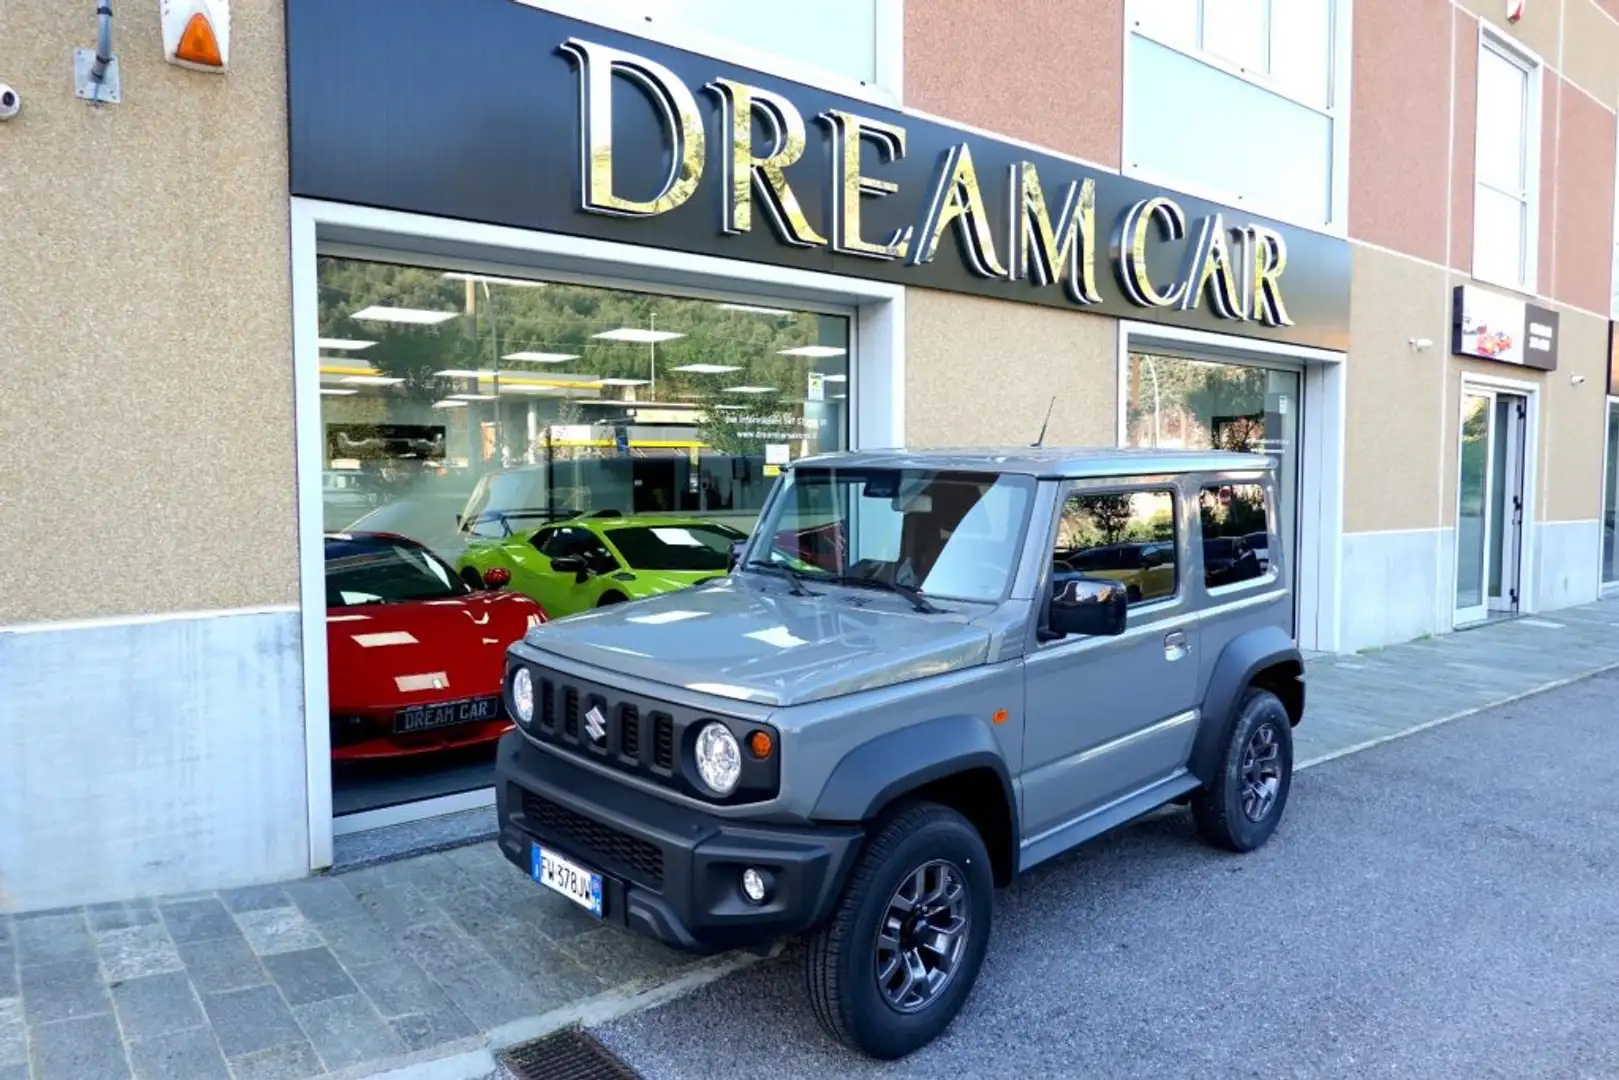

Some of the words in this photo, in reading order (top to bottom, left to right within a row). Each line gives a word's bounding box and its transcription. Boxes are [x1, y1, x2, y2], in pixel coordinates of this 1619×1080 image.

[558, 37, 1102, 305] DREAM
[1117, 196, 1295, 327] CAR
[405, 706, 455, 729] DREAM
[460, 701, 488, 719] CAR
